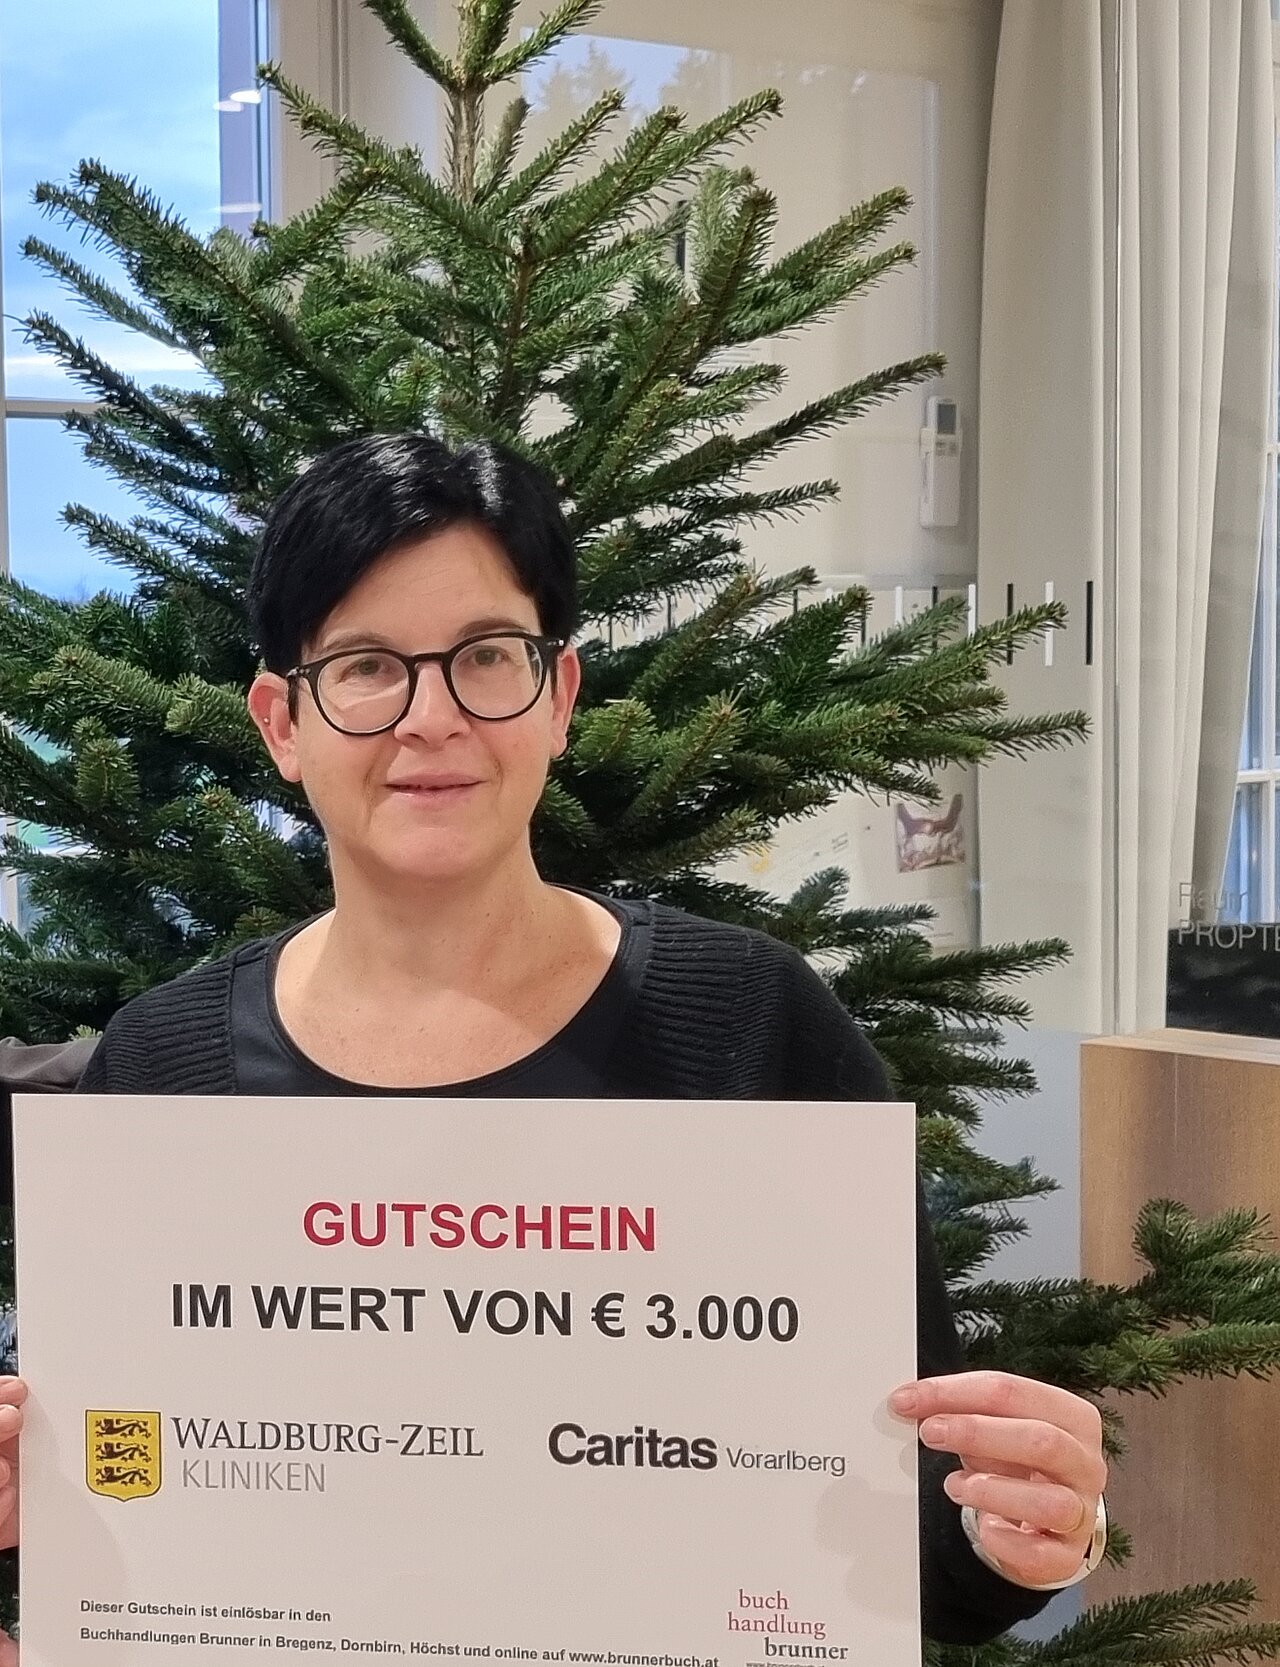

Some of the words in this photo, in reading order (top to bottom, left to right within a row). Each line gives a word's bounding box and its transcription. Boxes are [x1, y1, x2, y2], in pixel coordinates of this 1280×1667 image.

[303, 1201, 656, 1252] GUTSCHEIN
[171, 1283, 232, 1329] IM
[250, 1285, 427, 1332] WERT
[442, 1289, 572, 1336] VON
[590, 1292, 626, 1338] €
[645, 1294, 799, 1342] 3.000
[170, 1416, 484, 1457] WALDBURG-ZEIL
[548, 1422, 718, 1470] Caritas
[726, 1446, 847, 1477] Vorarlberg
[181, 1459, 325, 1493] KLINIKEN
[80, 1599, 124, 1614] Dieser
[127, 1601, 196, 1617] Gutschein
[200, 1604, 218, 1618] ist
[220, 1606, 286, 1620] einlösbar
[288, 1608, 302, 1621] in
[305, 1609, 332, 1622] den
[738, 1588, 789, 1610] buch
[727, 1611, 826, 1640] handlung
[80, 1627, 196, 1646] Buchhandlungen
[199, 1632, 257, 1647] Brunner
[258, 1634, 273, 1648] in
[275, 1635, 337, 1653] Bregenz,
[340, 1638, 406, 1656] Dornbirn,
[410, 1641, 461, 1657] Höchst
[463, 1644, 491, 1658] und
[494, 1646, 538, 1660] online
[541, 1648, 567, 1662] auf
[568, 1650, 720, 1667] www.brunnerbuch.at
[764, 1636, 849, 1660] brunner
